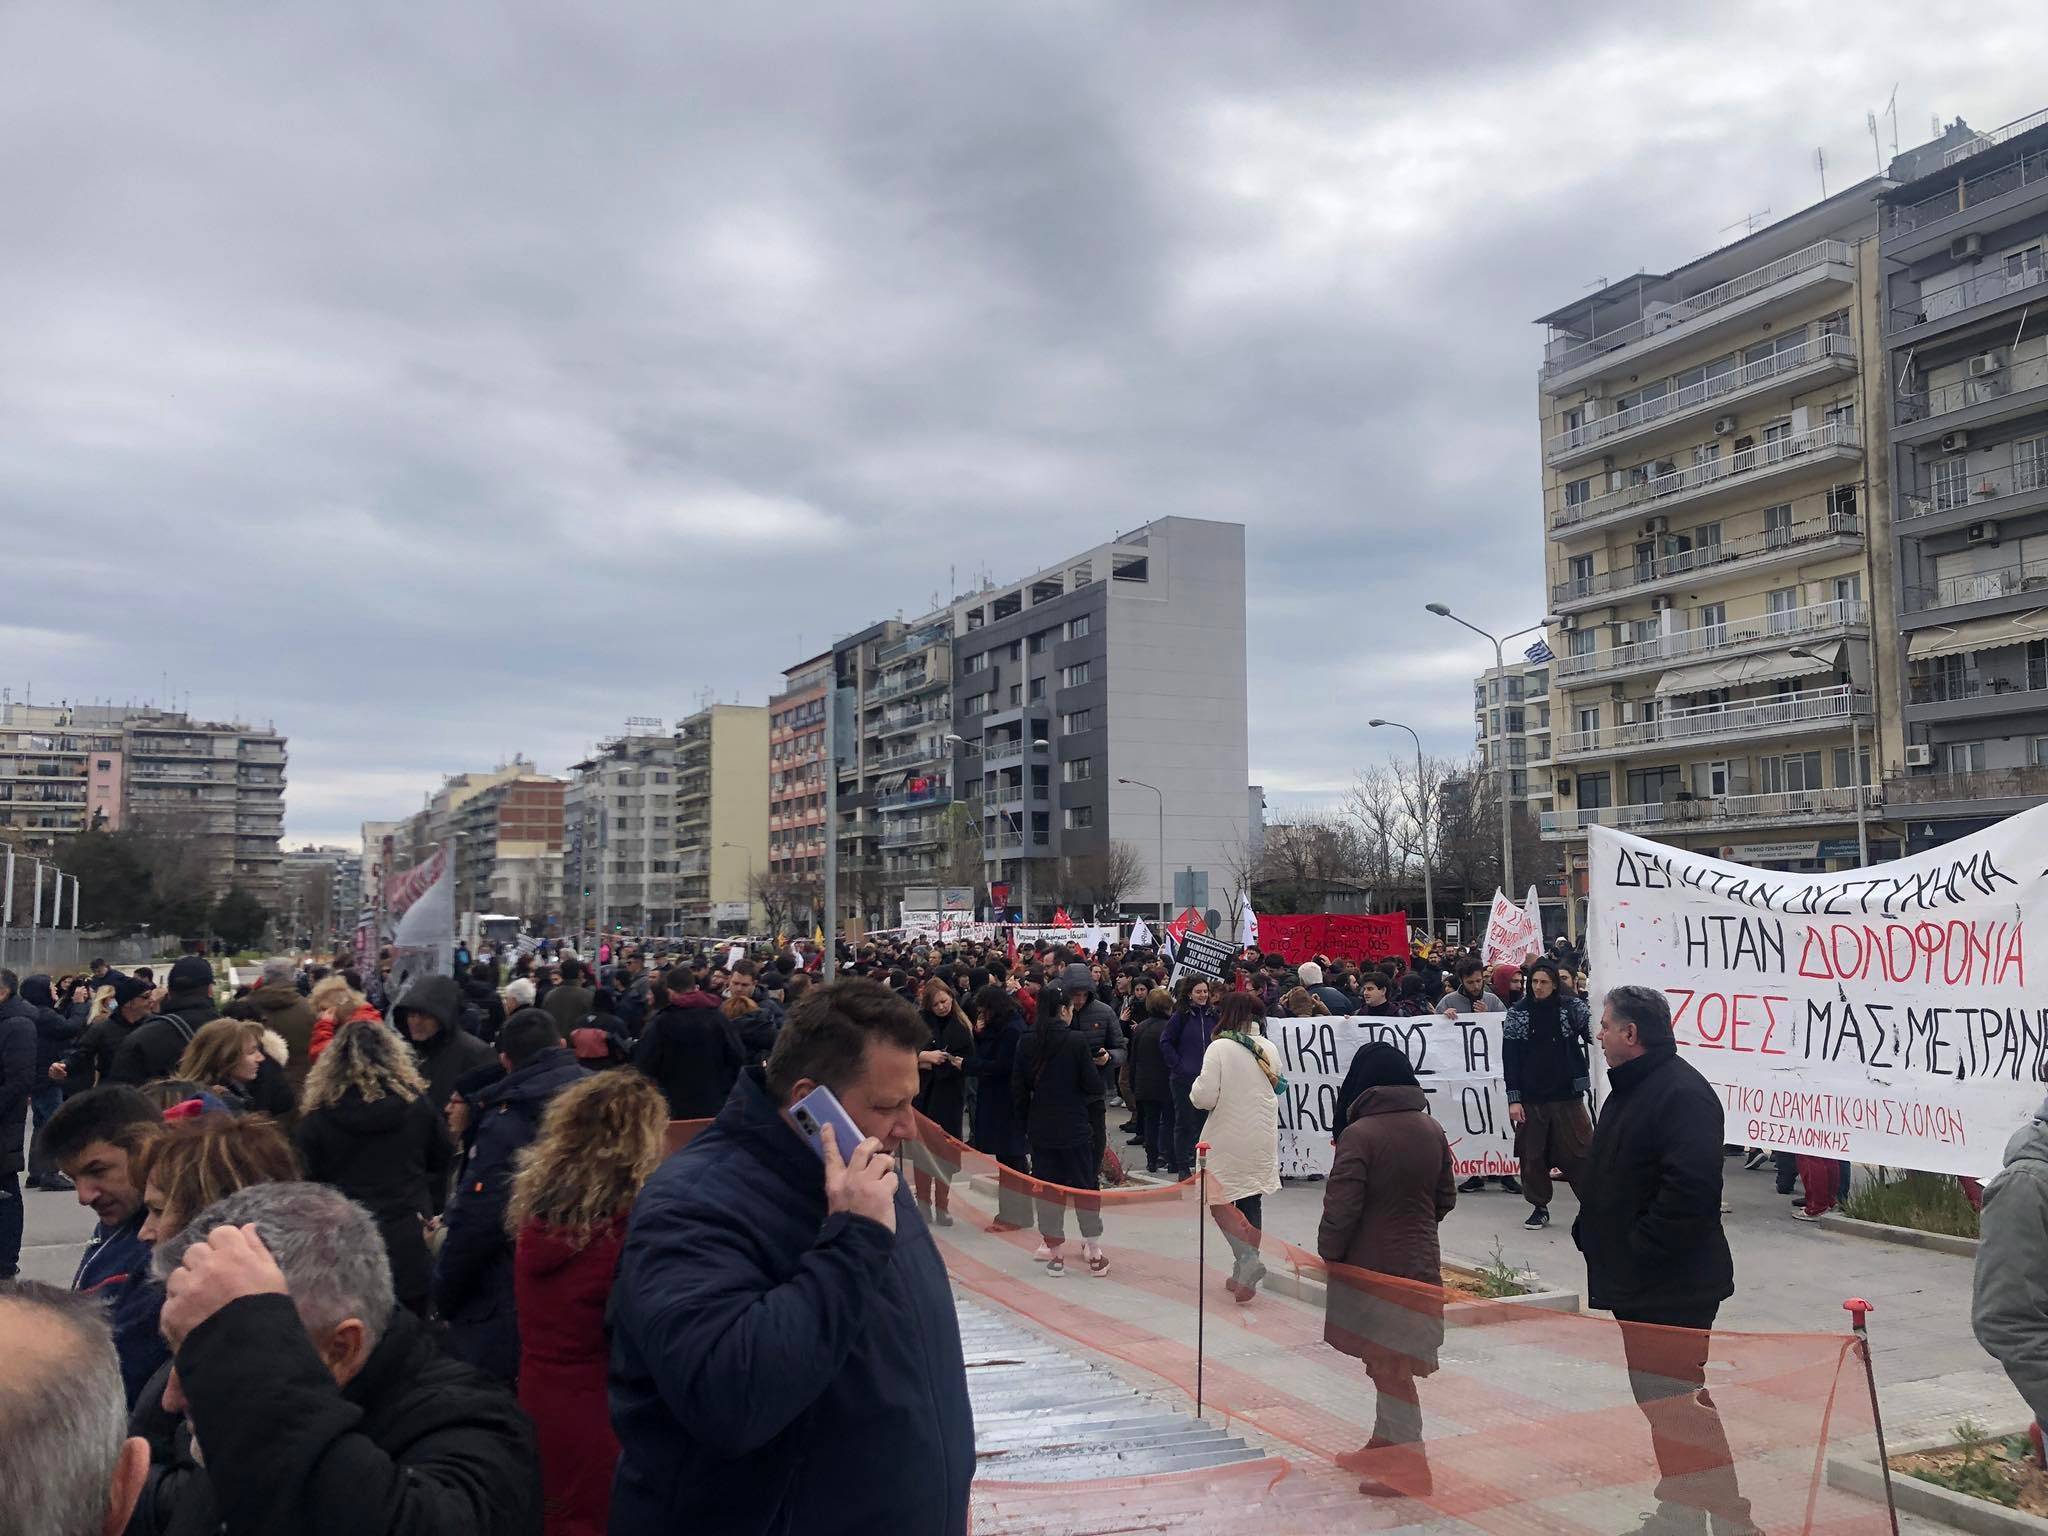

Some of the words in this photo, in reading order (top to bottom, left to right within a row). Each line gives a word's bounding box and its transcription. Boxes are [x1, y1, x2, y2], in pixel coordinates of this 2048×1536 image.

[1616, 847, 1672, 888] ΔΕΝ
[1783, 850, 2018, 915] ΔΥΣΤΥΧΗΜΑ
[1685, 915, 1786, 974] ΗΤΑΝ
[1798, 919, 2025, 988] ΔΟΛΟΦΟΝΙΑ
[1282, 1024, 1339, 1074] ΙΚΑ
[1454, 1021, 1490, 1072] ΤΑ
[1665, 987, 1790, 1055] ΖΩΕΣ
[1804, 998, 1894, 1068] ΜΑΣ
[1462, 1086, 1494, 1135] ΟΙ
[1711, 1083, 1764, 1113] ΤΙΚΟ
[1769, 1090, 1879, 1131] ΔΡΑΜΑΤΙΚΩΝ
[1882, 1100, 1966, 1146] ΣΧΟΛΩΝ
[1747, 1119, 1851, 1152] ΘΕΣΣΑΛΟΝΙΚΗΣ
